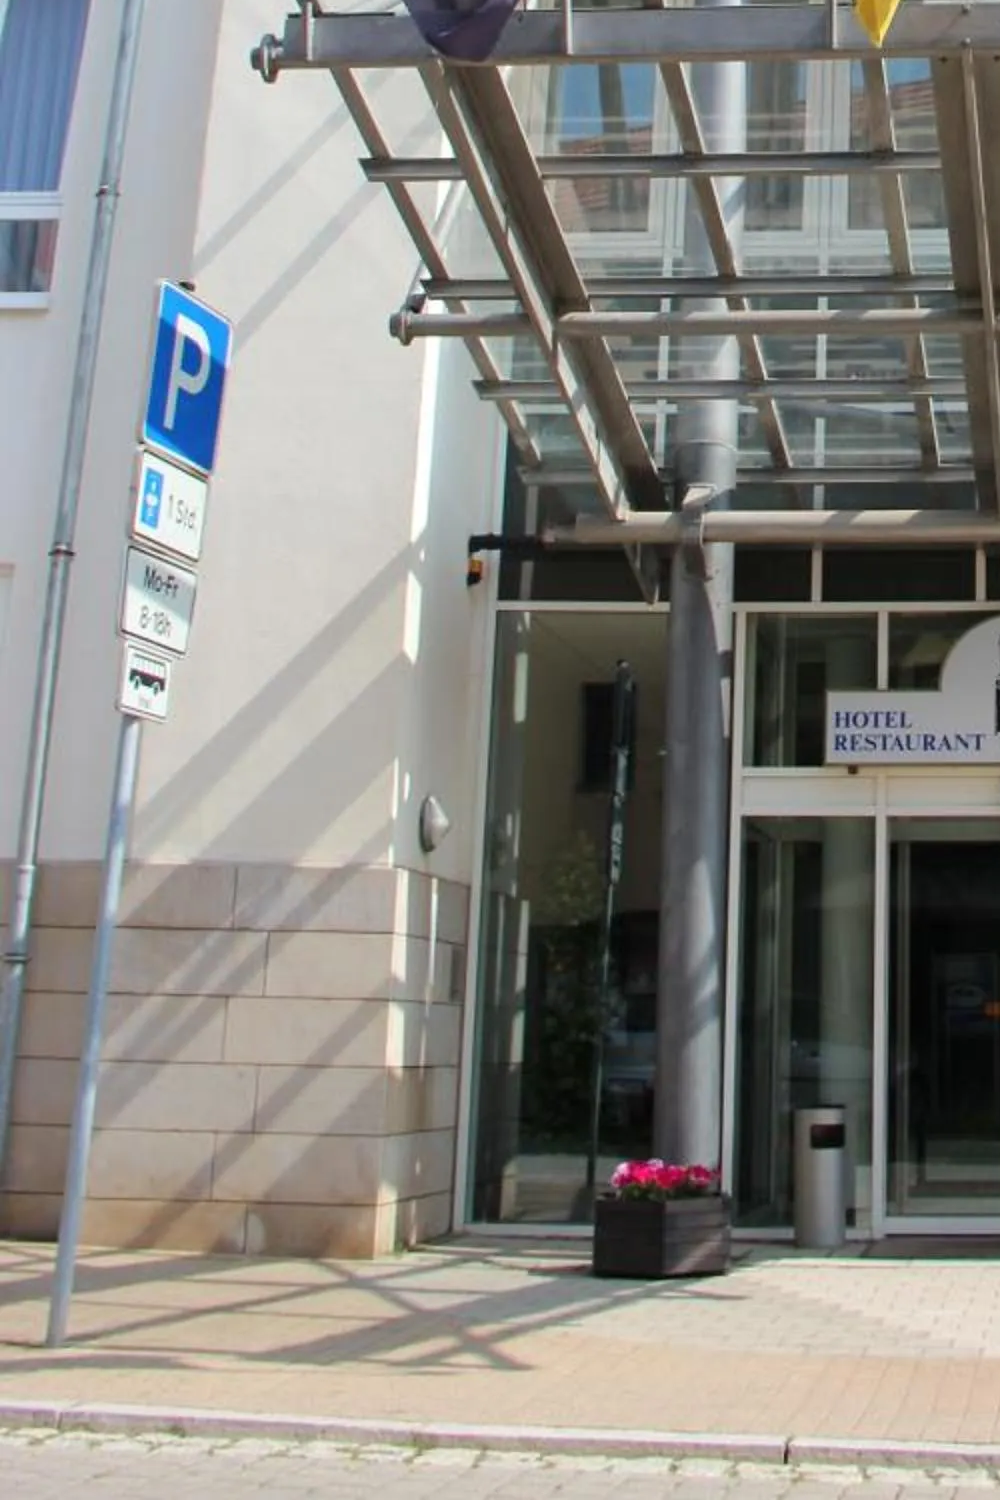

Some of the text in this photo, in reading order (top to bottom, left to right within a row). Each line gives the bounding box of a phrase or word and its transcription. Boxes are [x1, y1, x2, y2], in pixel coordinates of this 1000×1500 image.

[163, 312, 211, 431] P
[834, 710, 912, 730] HOTEL
[834, 732, 986, 752] RESTAURANT
